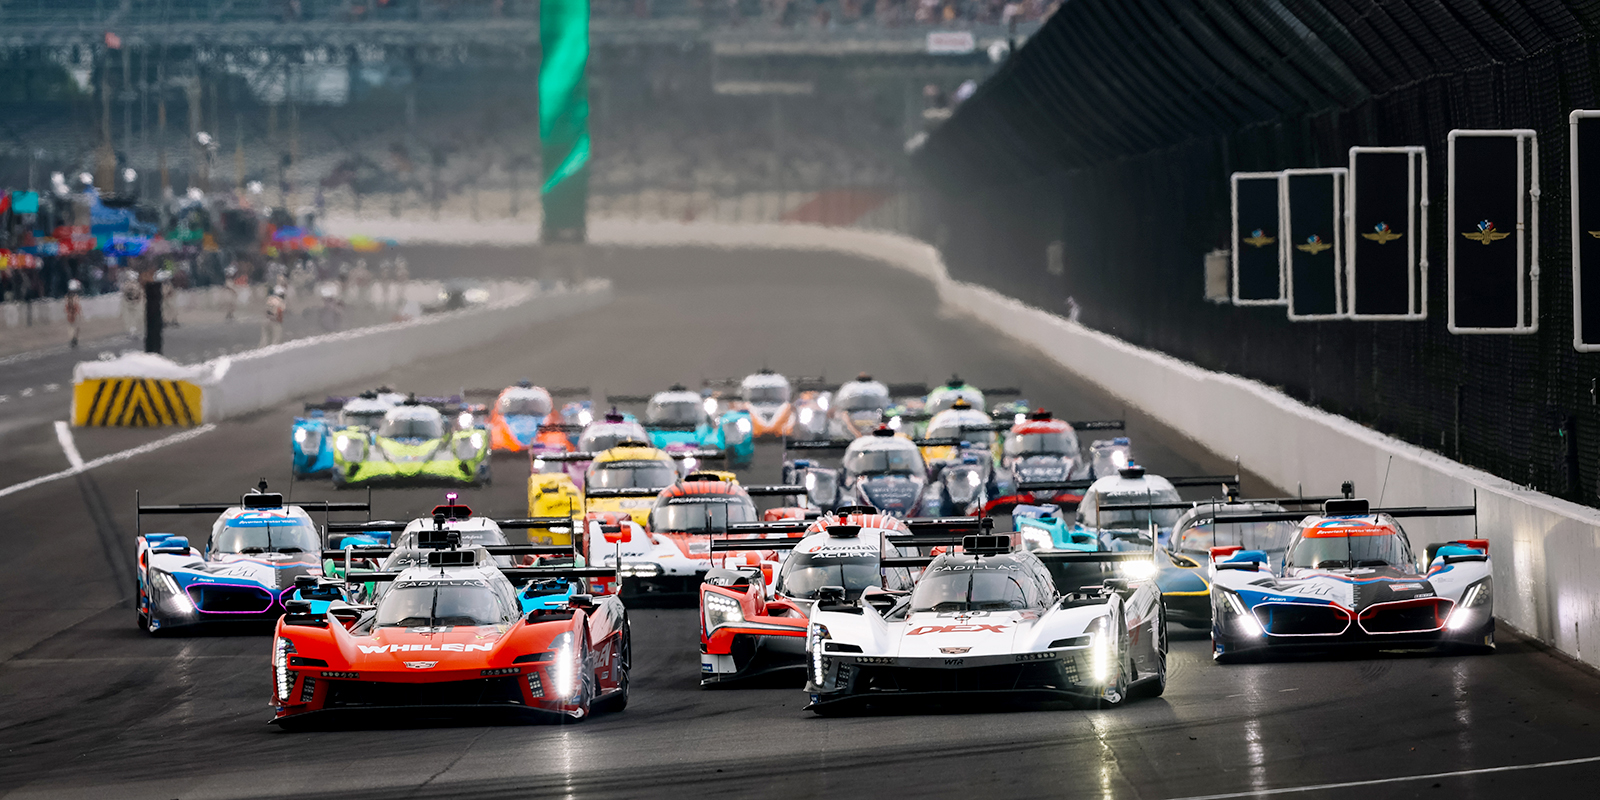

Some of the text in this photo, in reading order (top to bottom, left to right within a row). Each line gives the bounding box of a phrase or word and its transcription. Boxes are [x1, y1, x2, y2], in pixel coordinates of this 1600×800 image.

[933, 564, 1020, 573] CADILLAC
[397, 580, 485, 589] CADILLAC
[906, 624, 1009, 636] DEX
[357, 642, 494, 654] WHELEN
